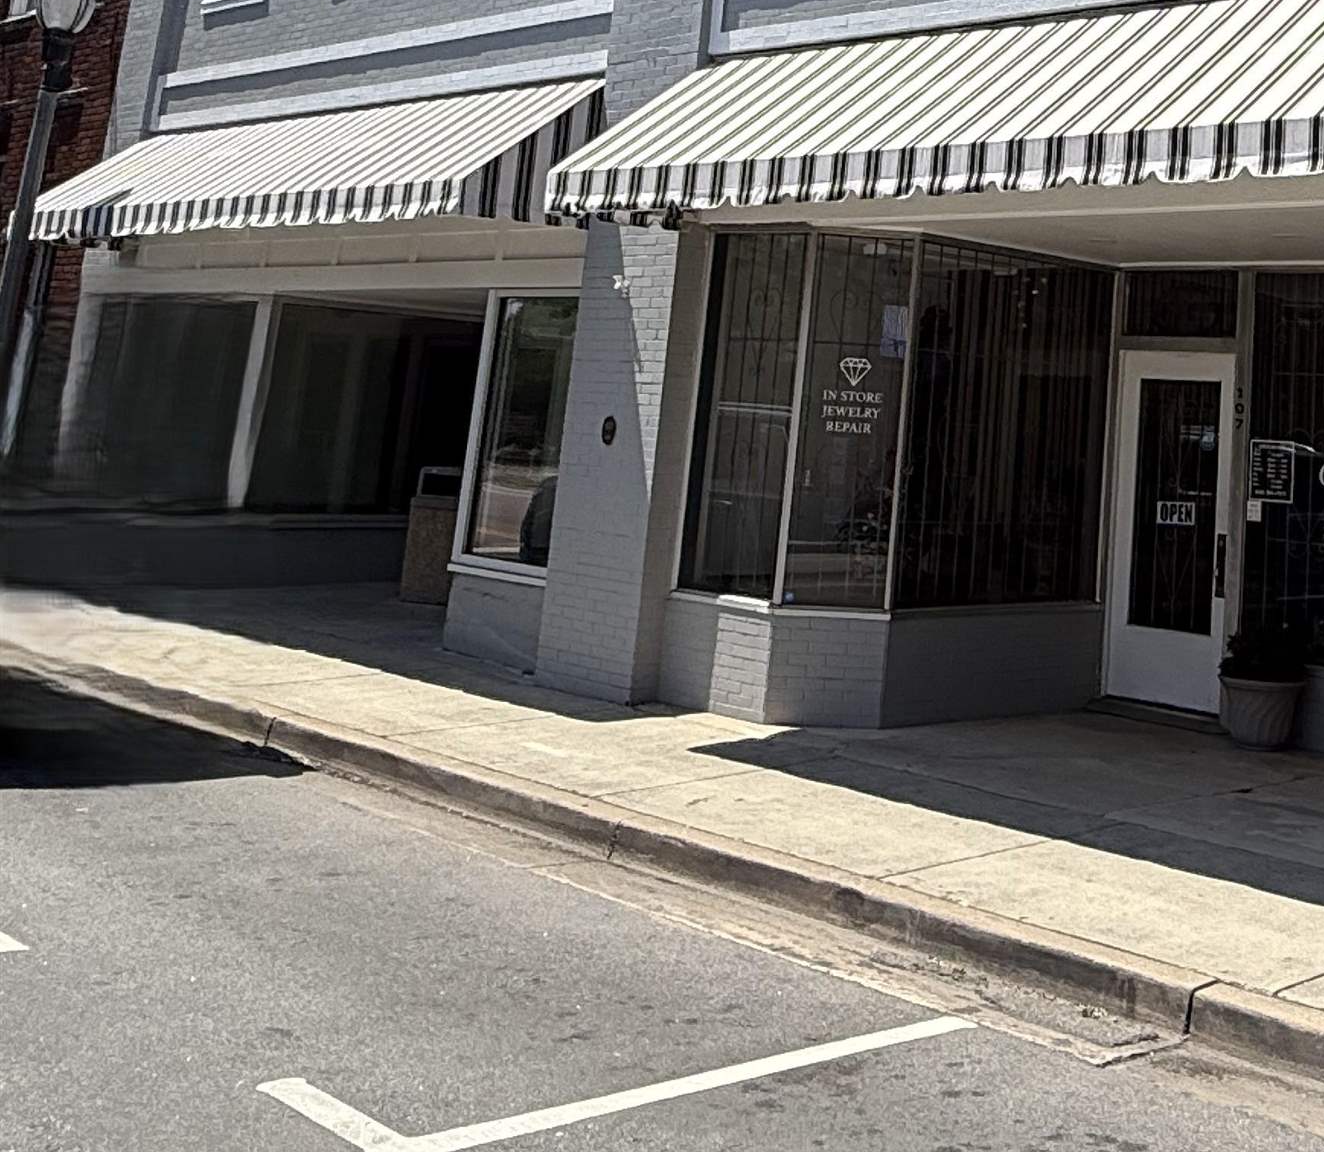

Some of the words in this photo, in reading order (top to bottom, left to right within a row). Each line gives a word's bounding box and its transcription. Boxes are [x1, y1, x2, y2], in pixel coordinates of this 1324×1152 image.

[822, 389, 838, 400] IN
[840, 390, 884, 403] STORE
[820, 405, 881, 419] JEWELRY
[825, 421, 872, 434] REPAIR
[1160, 503, 1193, 523] OPEN
